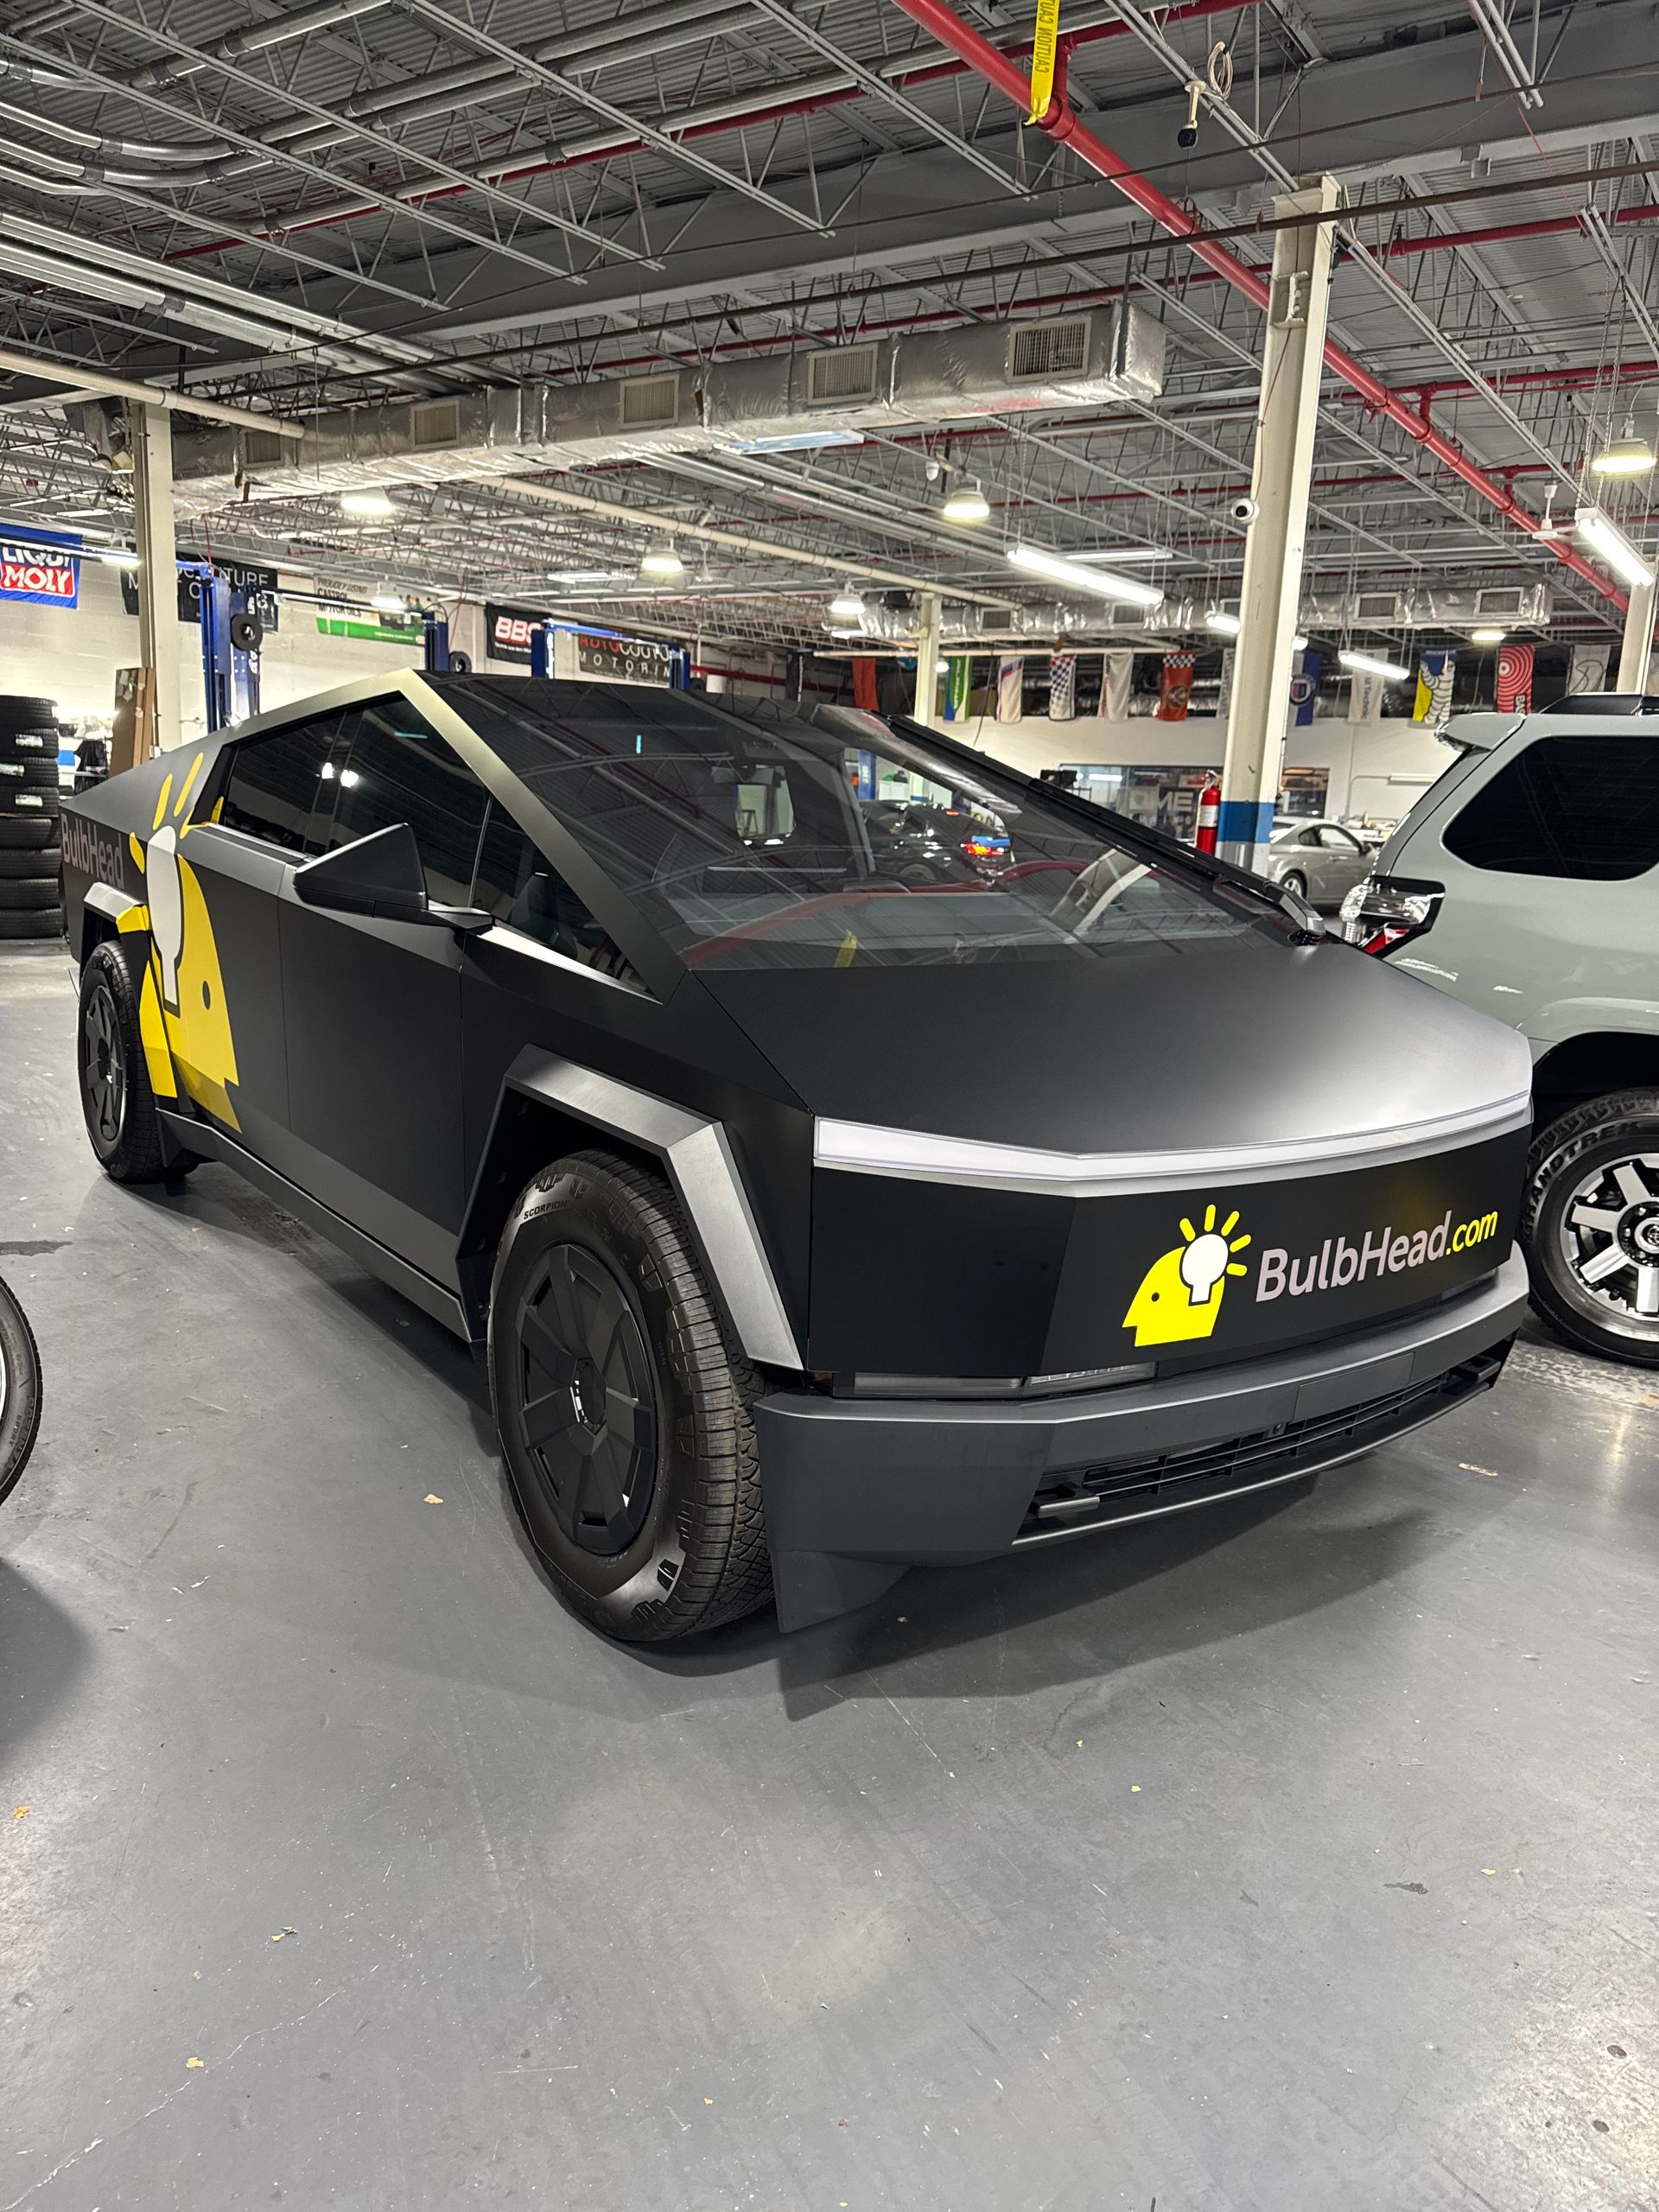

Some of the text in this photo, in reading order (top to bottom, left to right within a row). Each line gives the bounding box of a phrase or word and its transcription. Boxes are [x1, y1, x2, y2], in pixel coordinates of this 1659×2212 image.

[3, 565, 71, 594] MOLY
[60, 812, 124, 889] BulbHead
[523, 1200, 568, 1220] SCORPION
[1255, 1210, 1498, 1303] BulbHead.com
